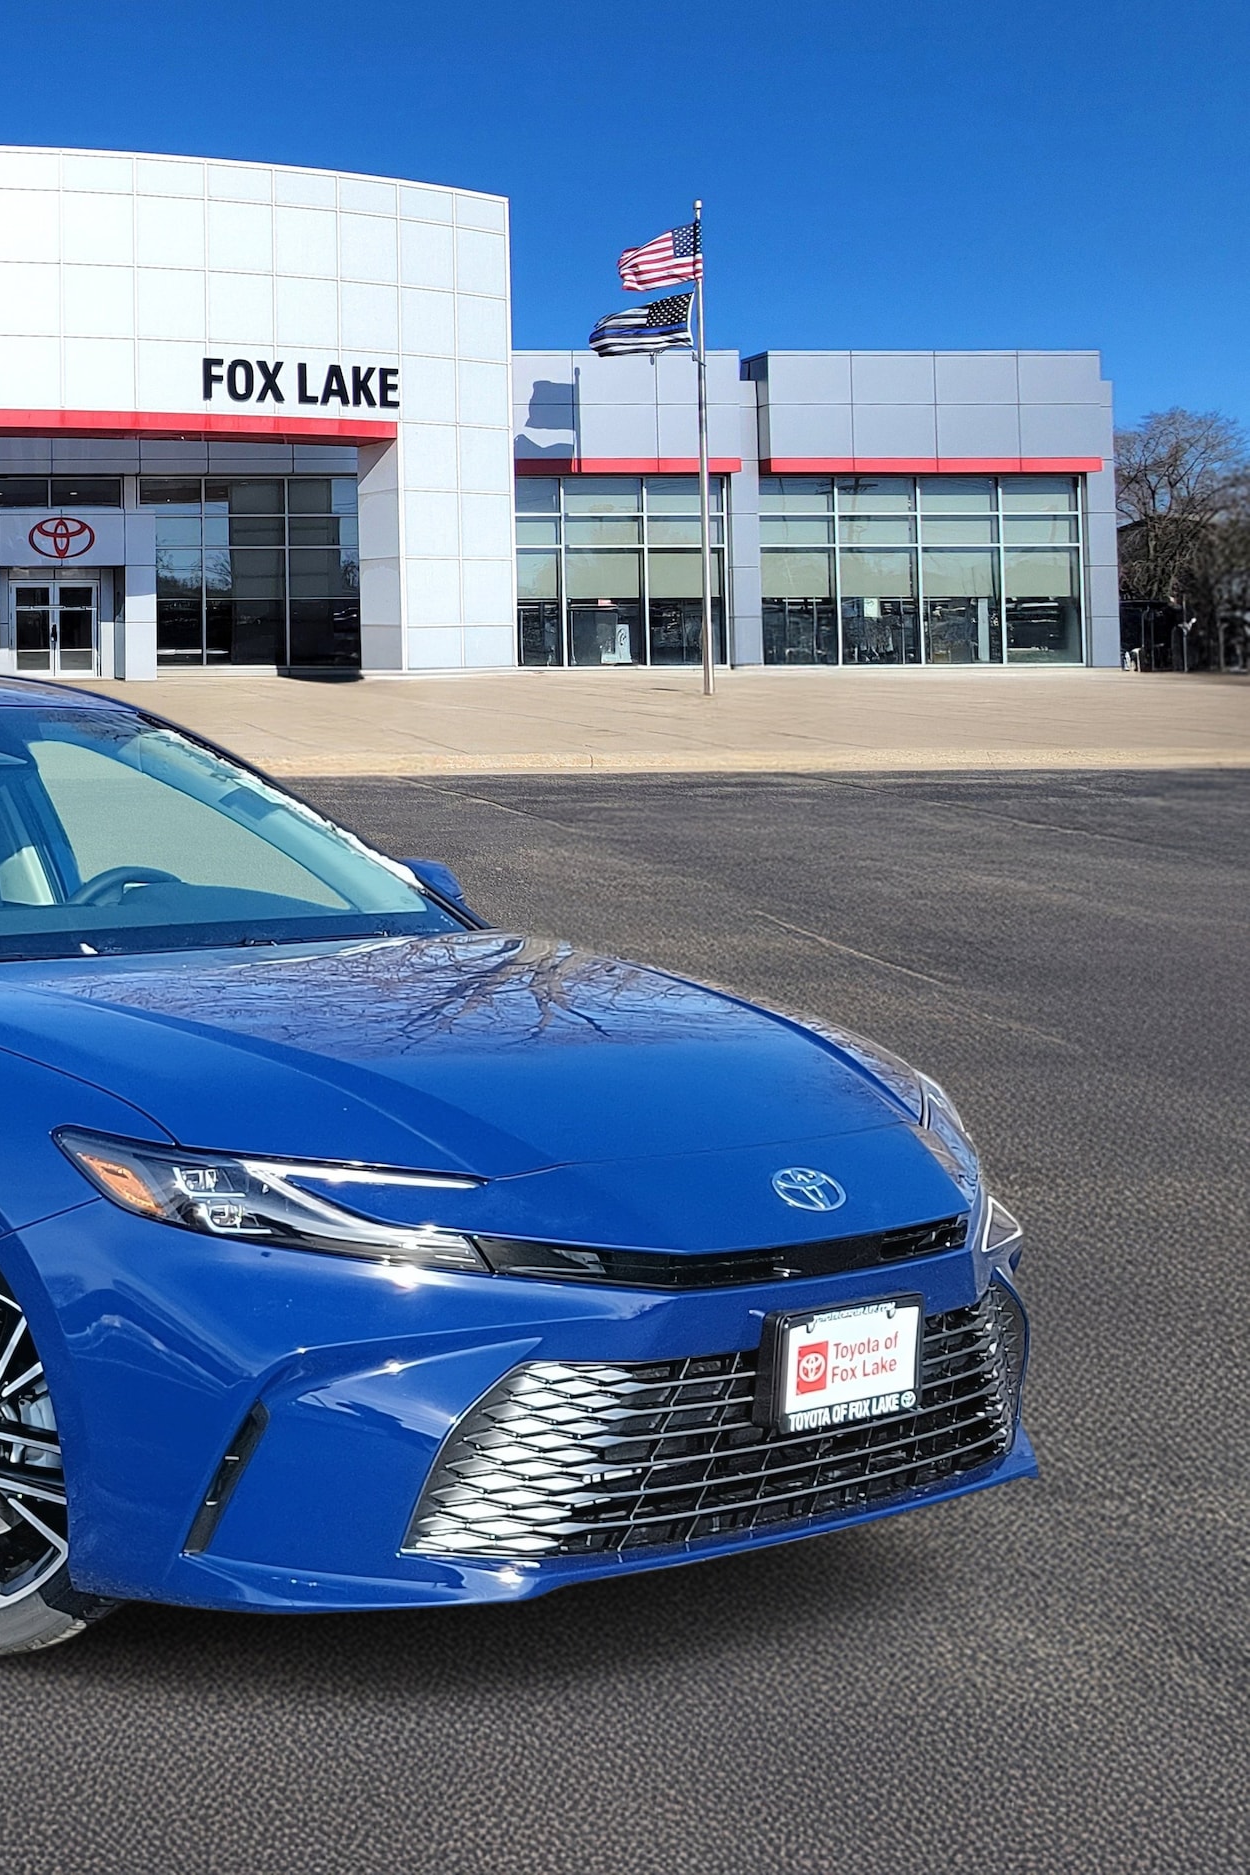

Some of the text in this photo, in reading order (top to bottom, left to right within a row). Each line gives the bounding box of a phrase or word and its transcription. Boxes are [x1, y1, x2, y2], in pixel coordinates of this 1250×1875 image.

[202, 357, 400, 407] FOX LAKE
[833, 1331, 899, 1362] Toyota of
[831, 1356, 897, 1384] Fox Lake
[788, 1394, 900, 1432] TOYOTA OF FOX LAKE
